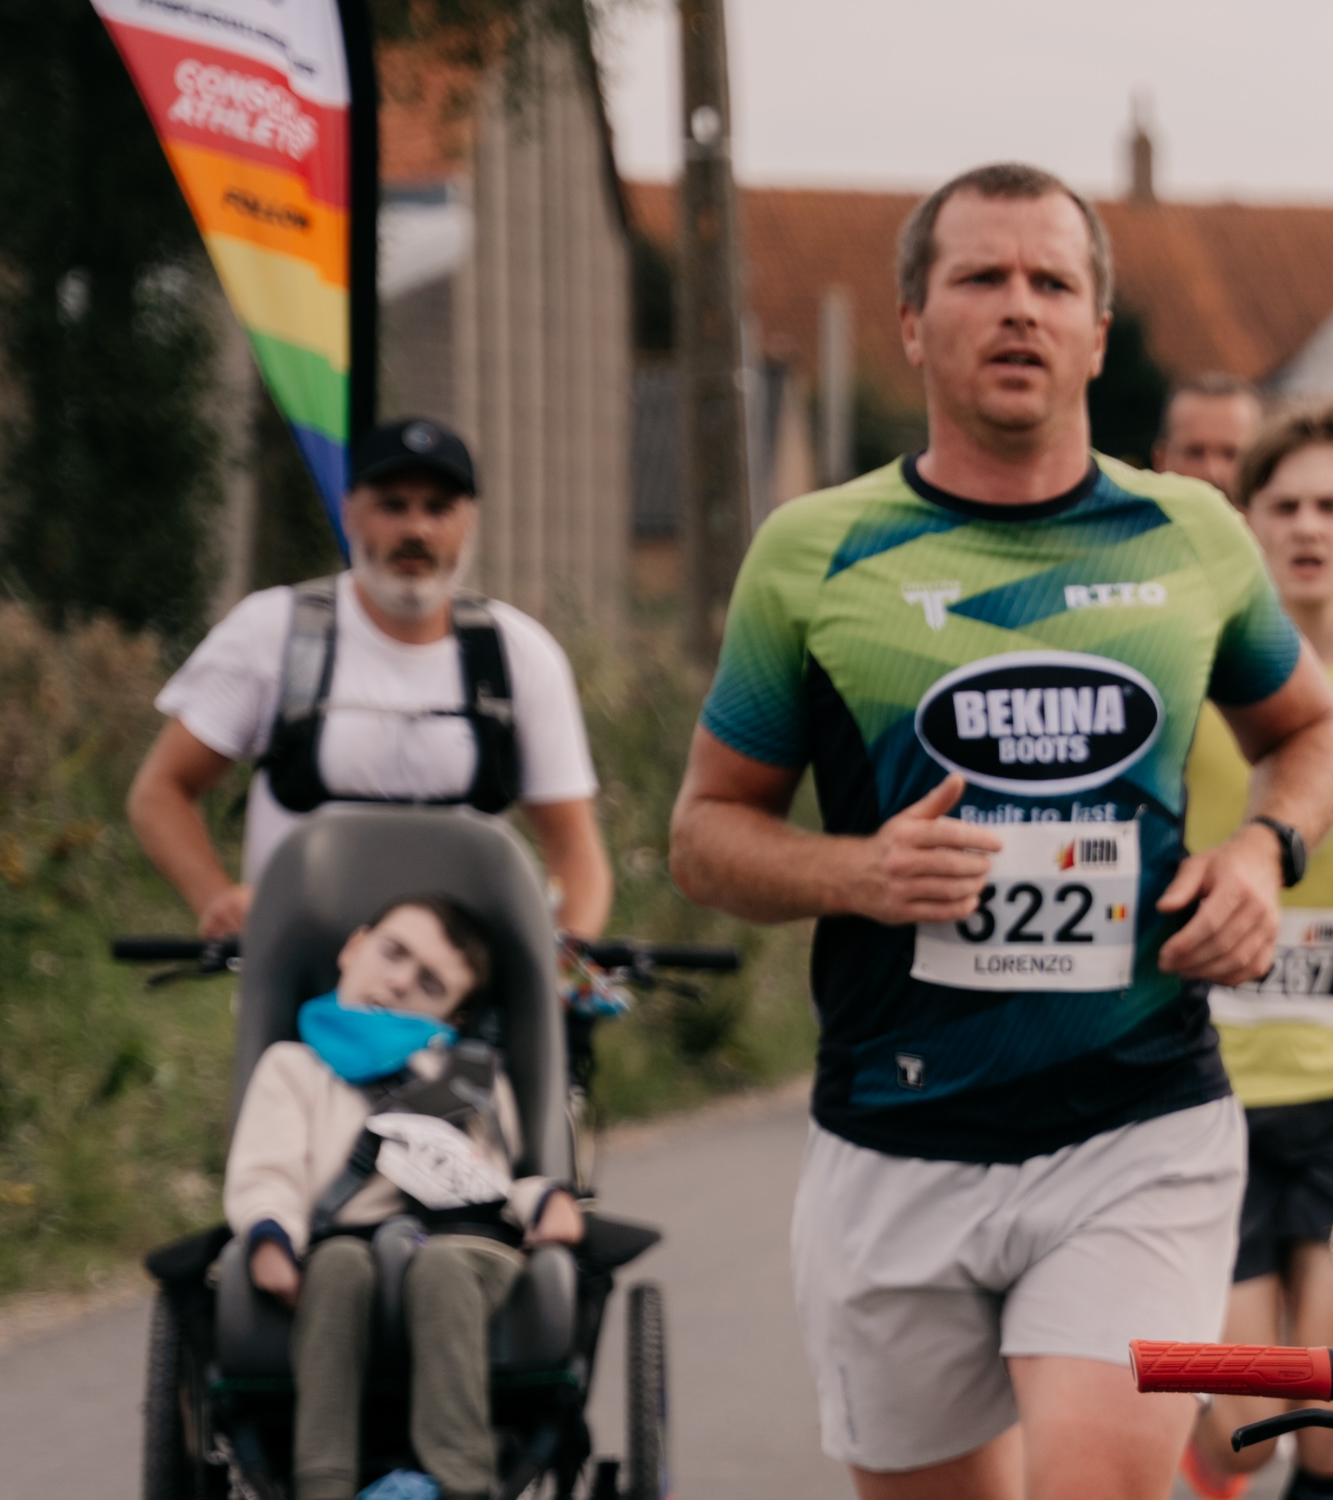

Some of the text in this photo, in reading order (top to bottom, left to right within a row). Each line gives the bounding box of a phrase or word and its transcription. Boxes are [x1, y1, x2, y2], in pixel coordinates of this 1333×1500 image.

[952, 684, 1127, 739] BEKINA
[998, 735, 1090, 764] BOOTS
[957, 882, 1094, 943] 322
[973, 955, 1074, 974] LORENZO
